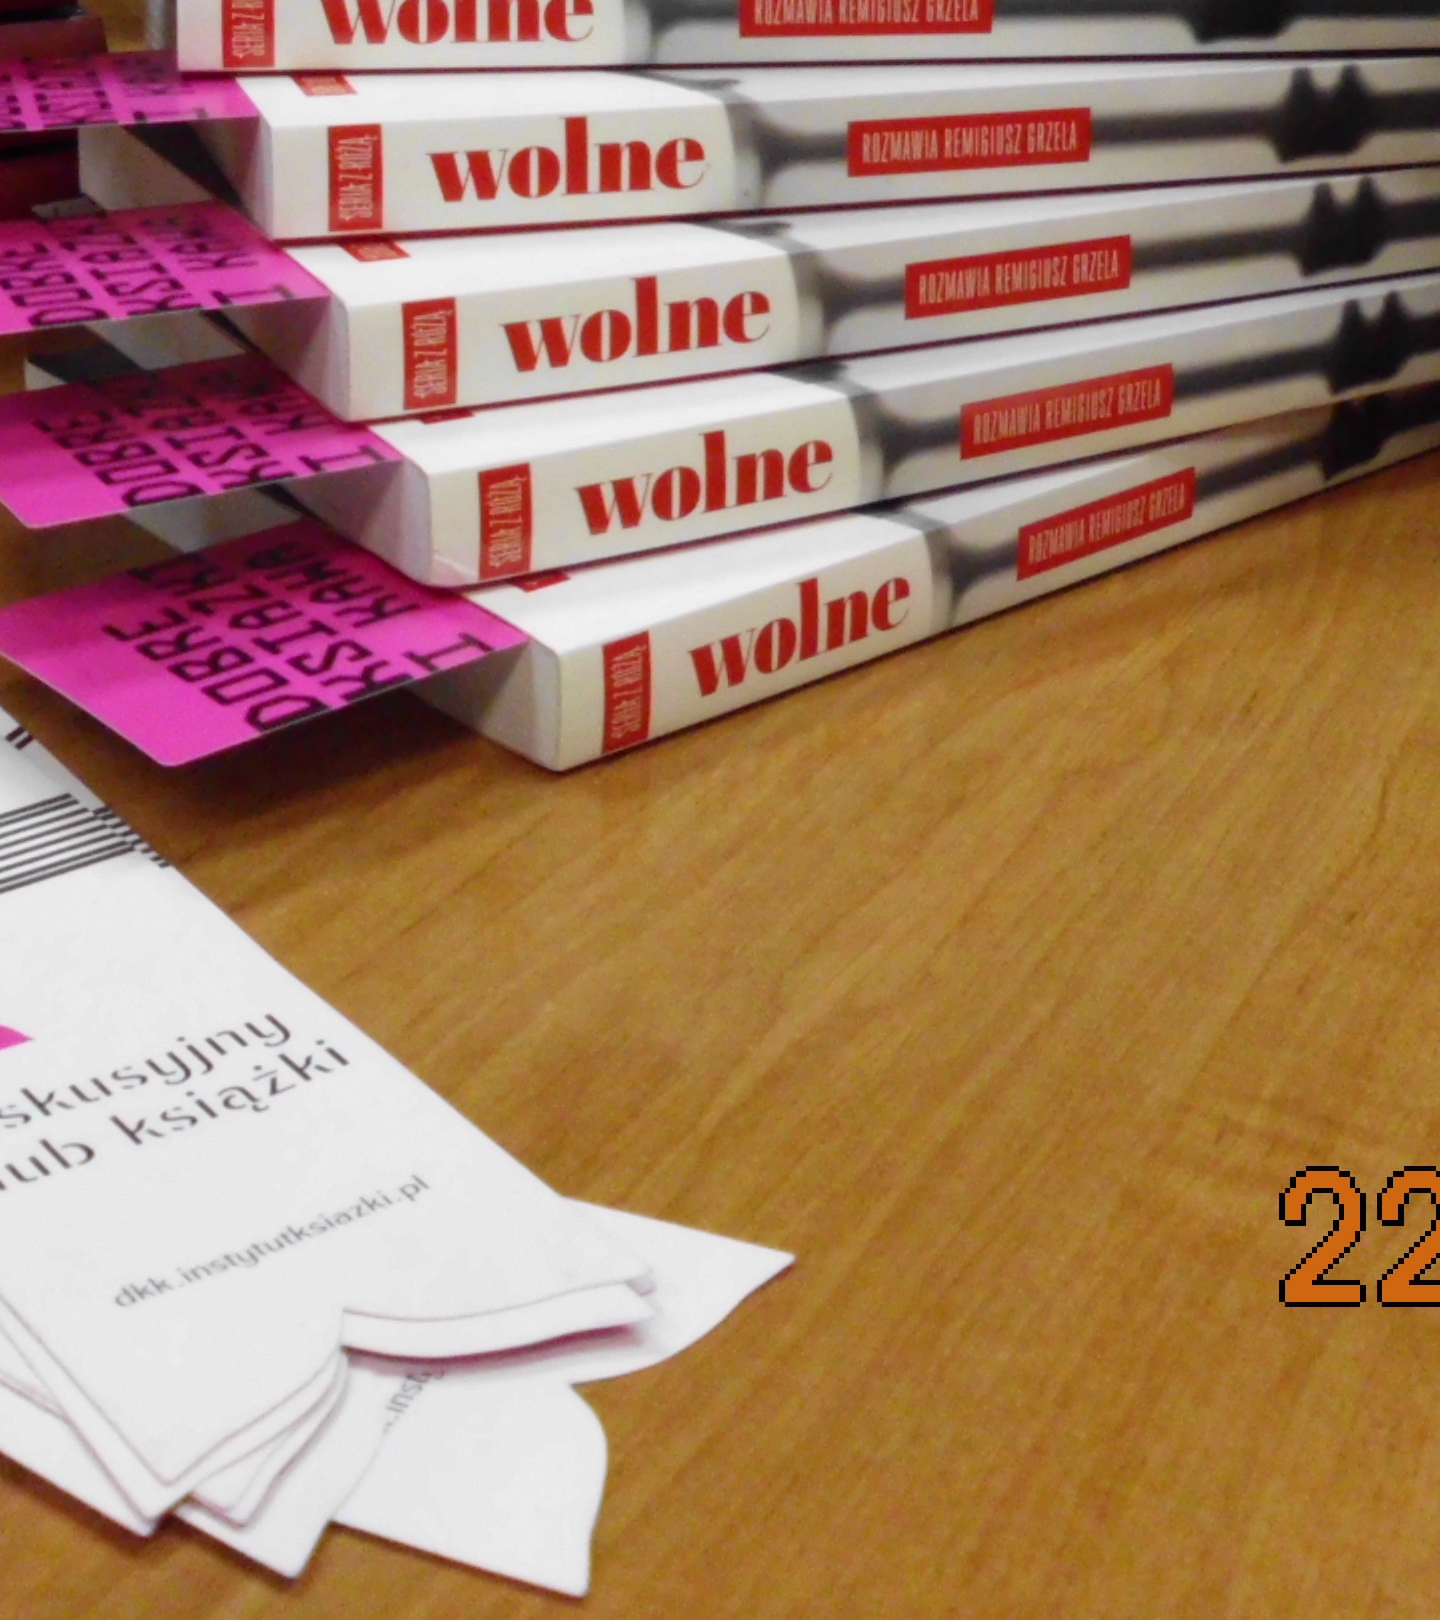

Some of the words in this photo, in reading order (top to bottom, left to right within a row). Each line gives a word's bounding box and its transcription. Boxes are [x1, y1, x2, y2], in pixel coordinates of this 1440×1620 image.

[425, 116, 706, 203] wolne
[862, 131, 938, 164] ROZMAWIA
[943, 125, 1022, 159] REMIGIUSZ
[1026, 121, 1078, 154] GRZELA
[917, 266, 991, 306] ROZMAWIA
[994, 257, 1070, 296] REMIGIUSZ
[1071, 247, 1119, 285] GRZELA
[498, 275, 771, 373] wolne
[972, 404, 1040, 443] ROZMAWIA
[1044, 389, 1115, 430] REMIGIUSZ
[1117, 377, 1162, 416] GRZELA
[573, 429, 834, 536] wolne
[1027, 518, 1086, 564] ROZMAWIA
[1087, 497, 1146, 543] REMIGIUSZ
[1147, 481, 1186, 520] GRZELA
[687, 577, 911, 698] wolne
[109, 1037, 351, 1147] książki
[113, 1173, 431, 1309] dkk.instytutksiazki.pl
